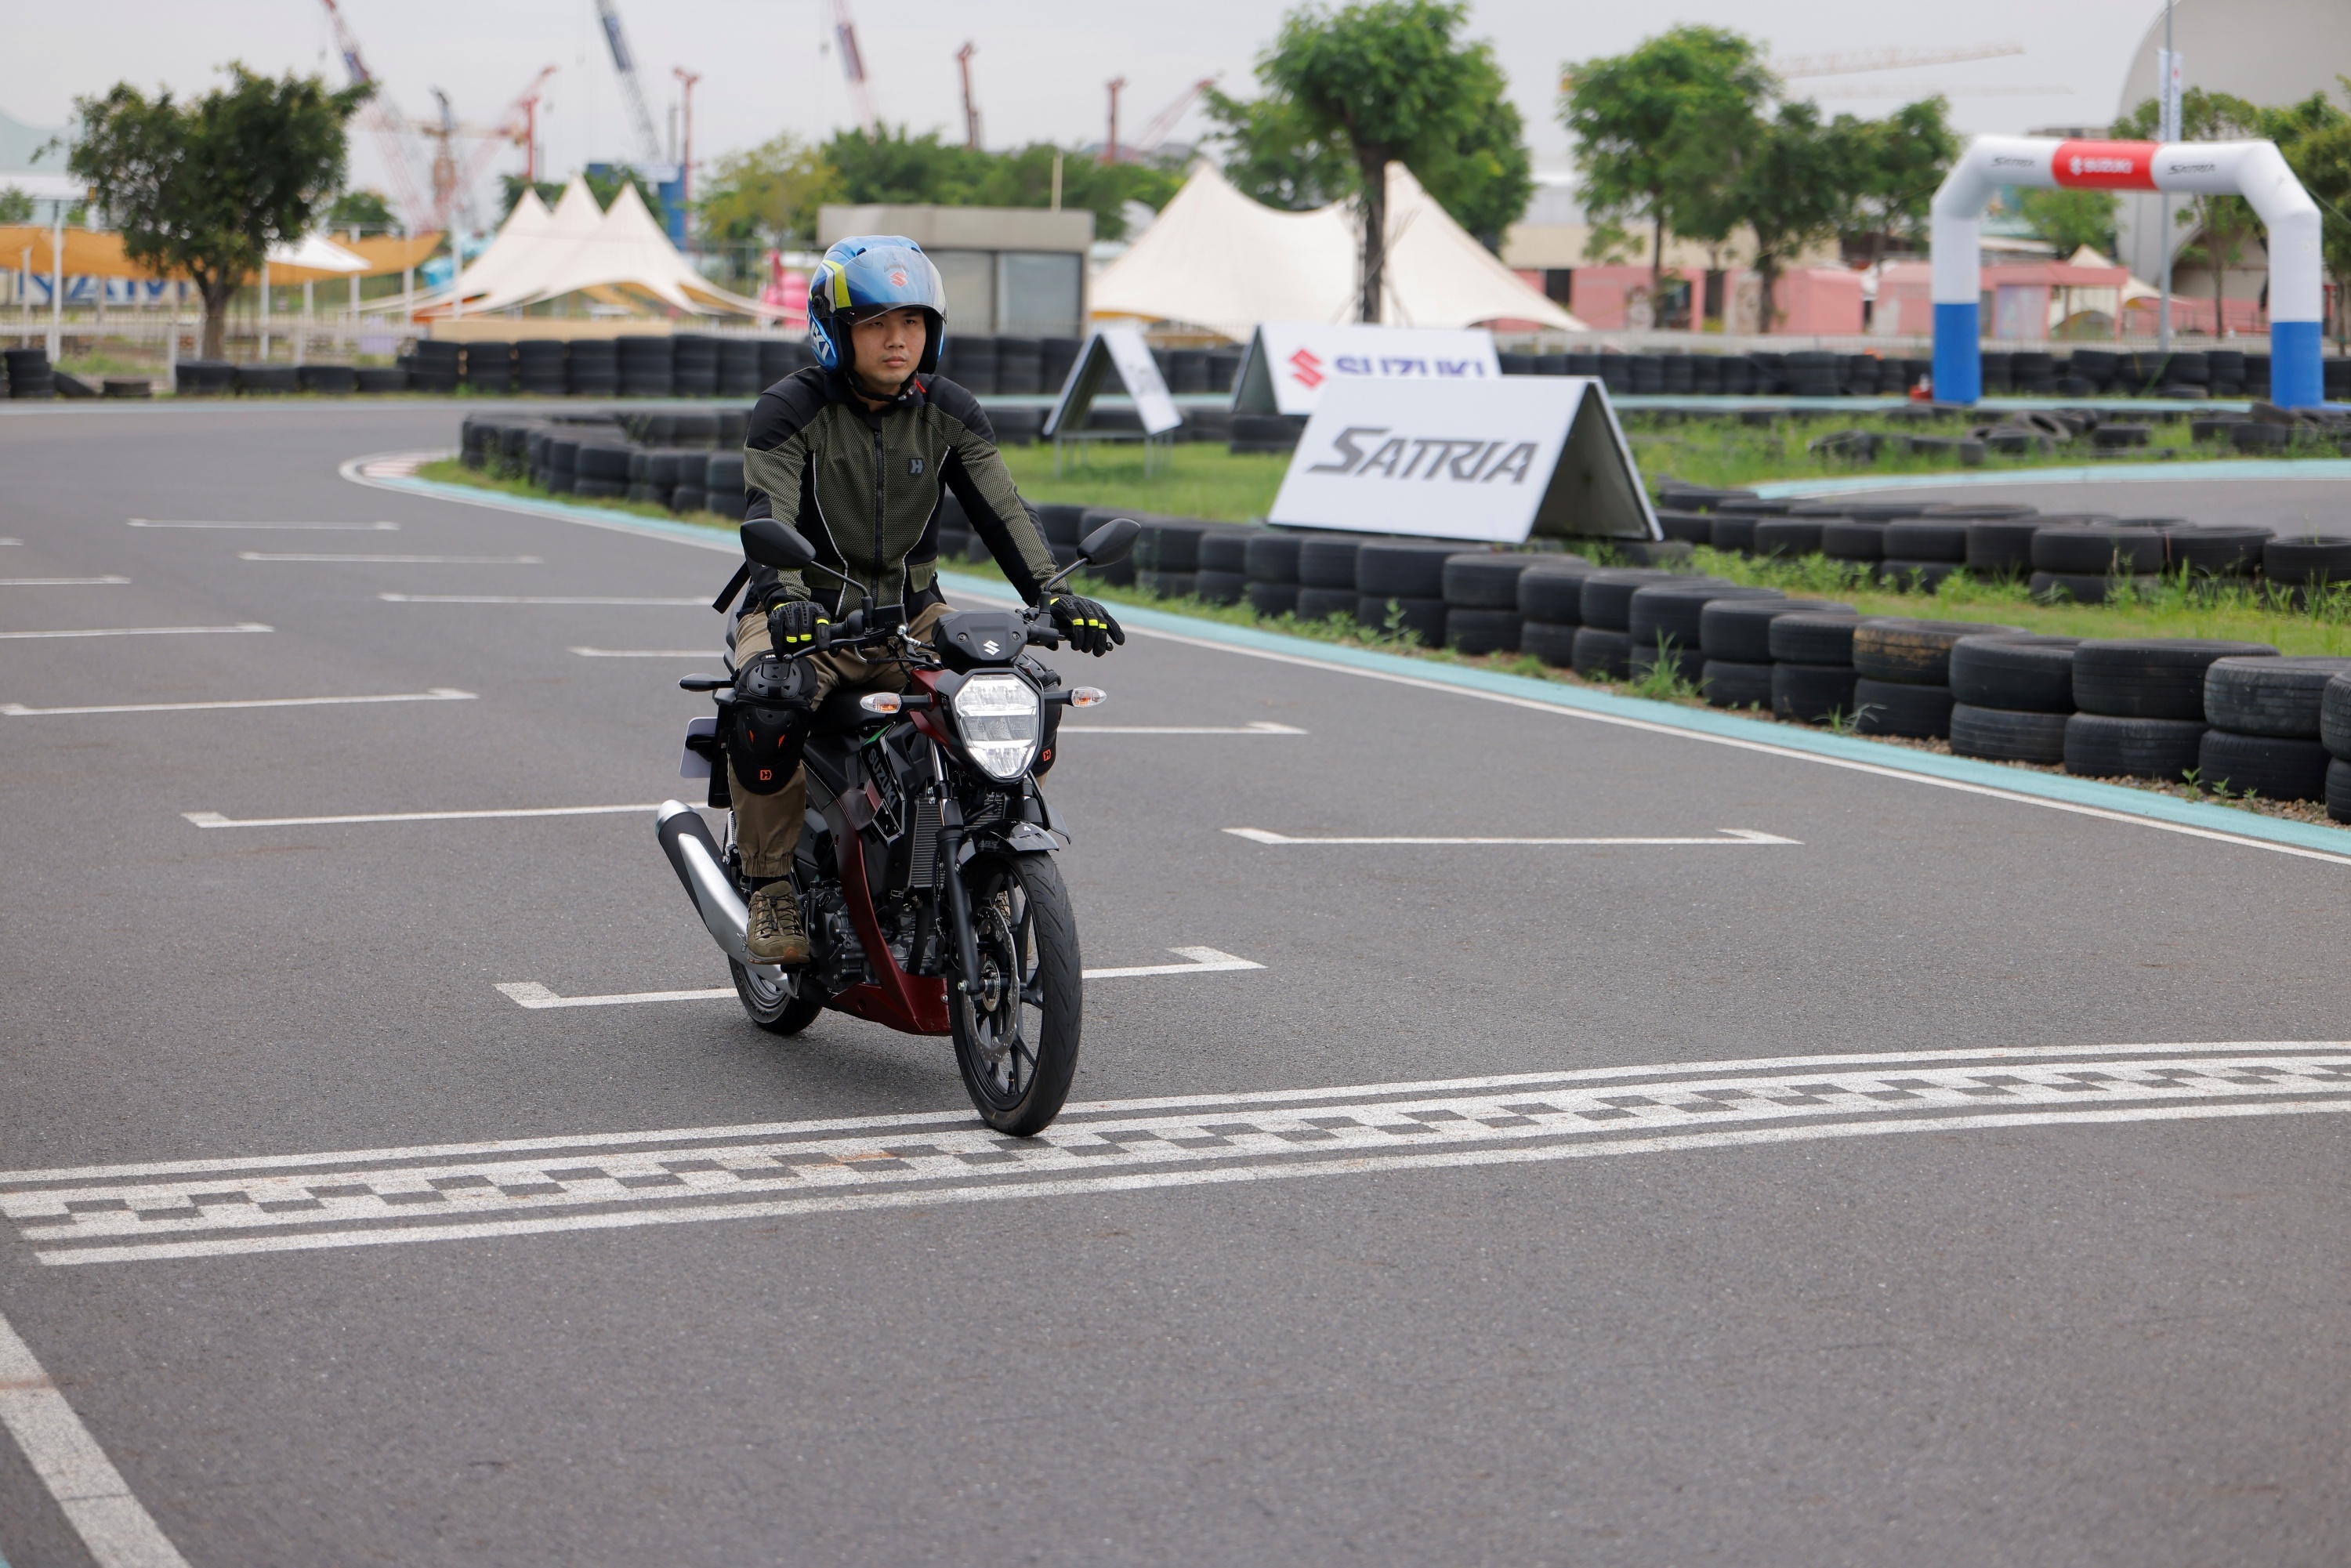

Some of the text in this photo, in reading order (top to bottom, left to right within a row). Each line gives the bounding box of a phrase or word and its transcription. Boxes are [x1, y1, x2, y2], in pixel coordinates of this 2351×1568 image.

[2084, 158, 2133, 175] SUZUKI
[2167, 163, 2216, 175] SATRIA
[1305, 426, 1540, 484] SATRIA
[868, 748, 898, 809] SUZUKI
